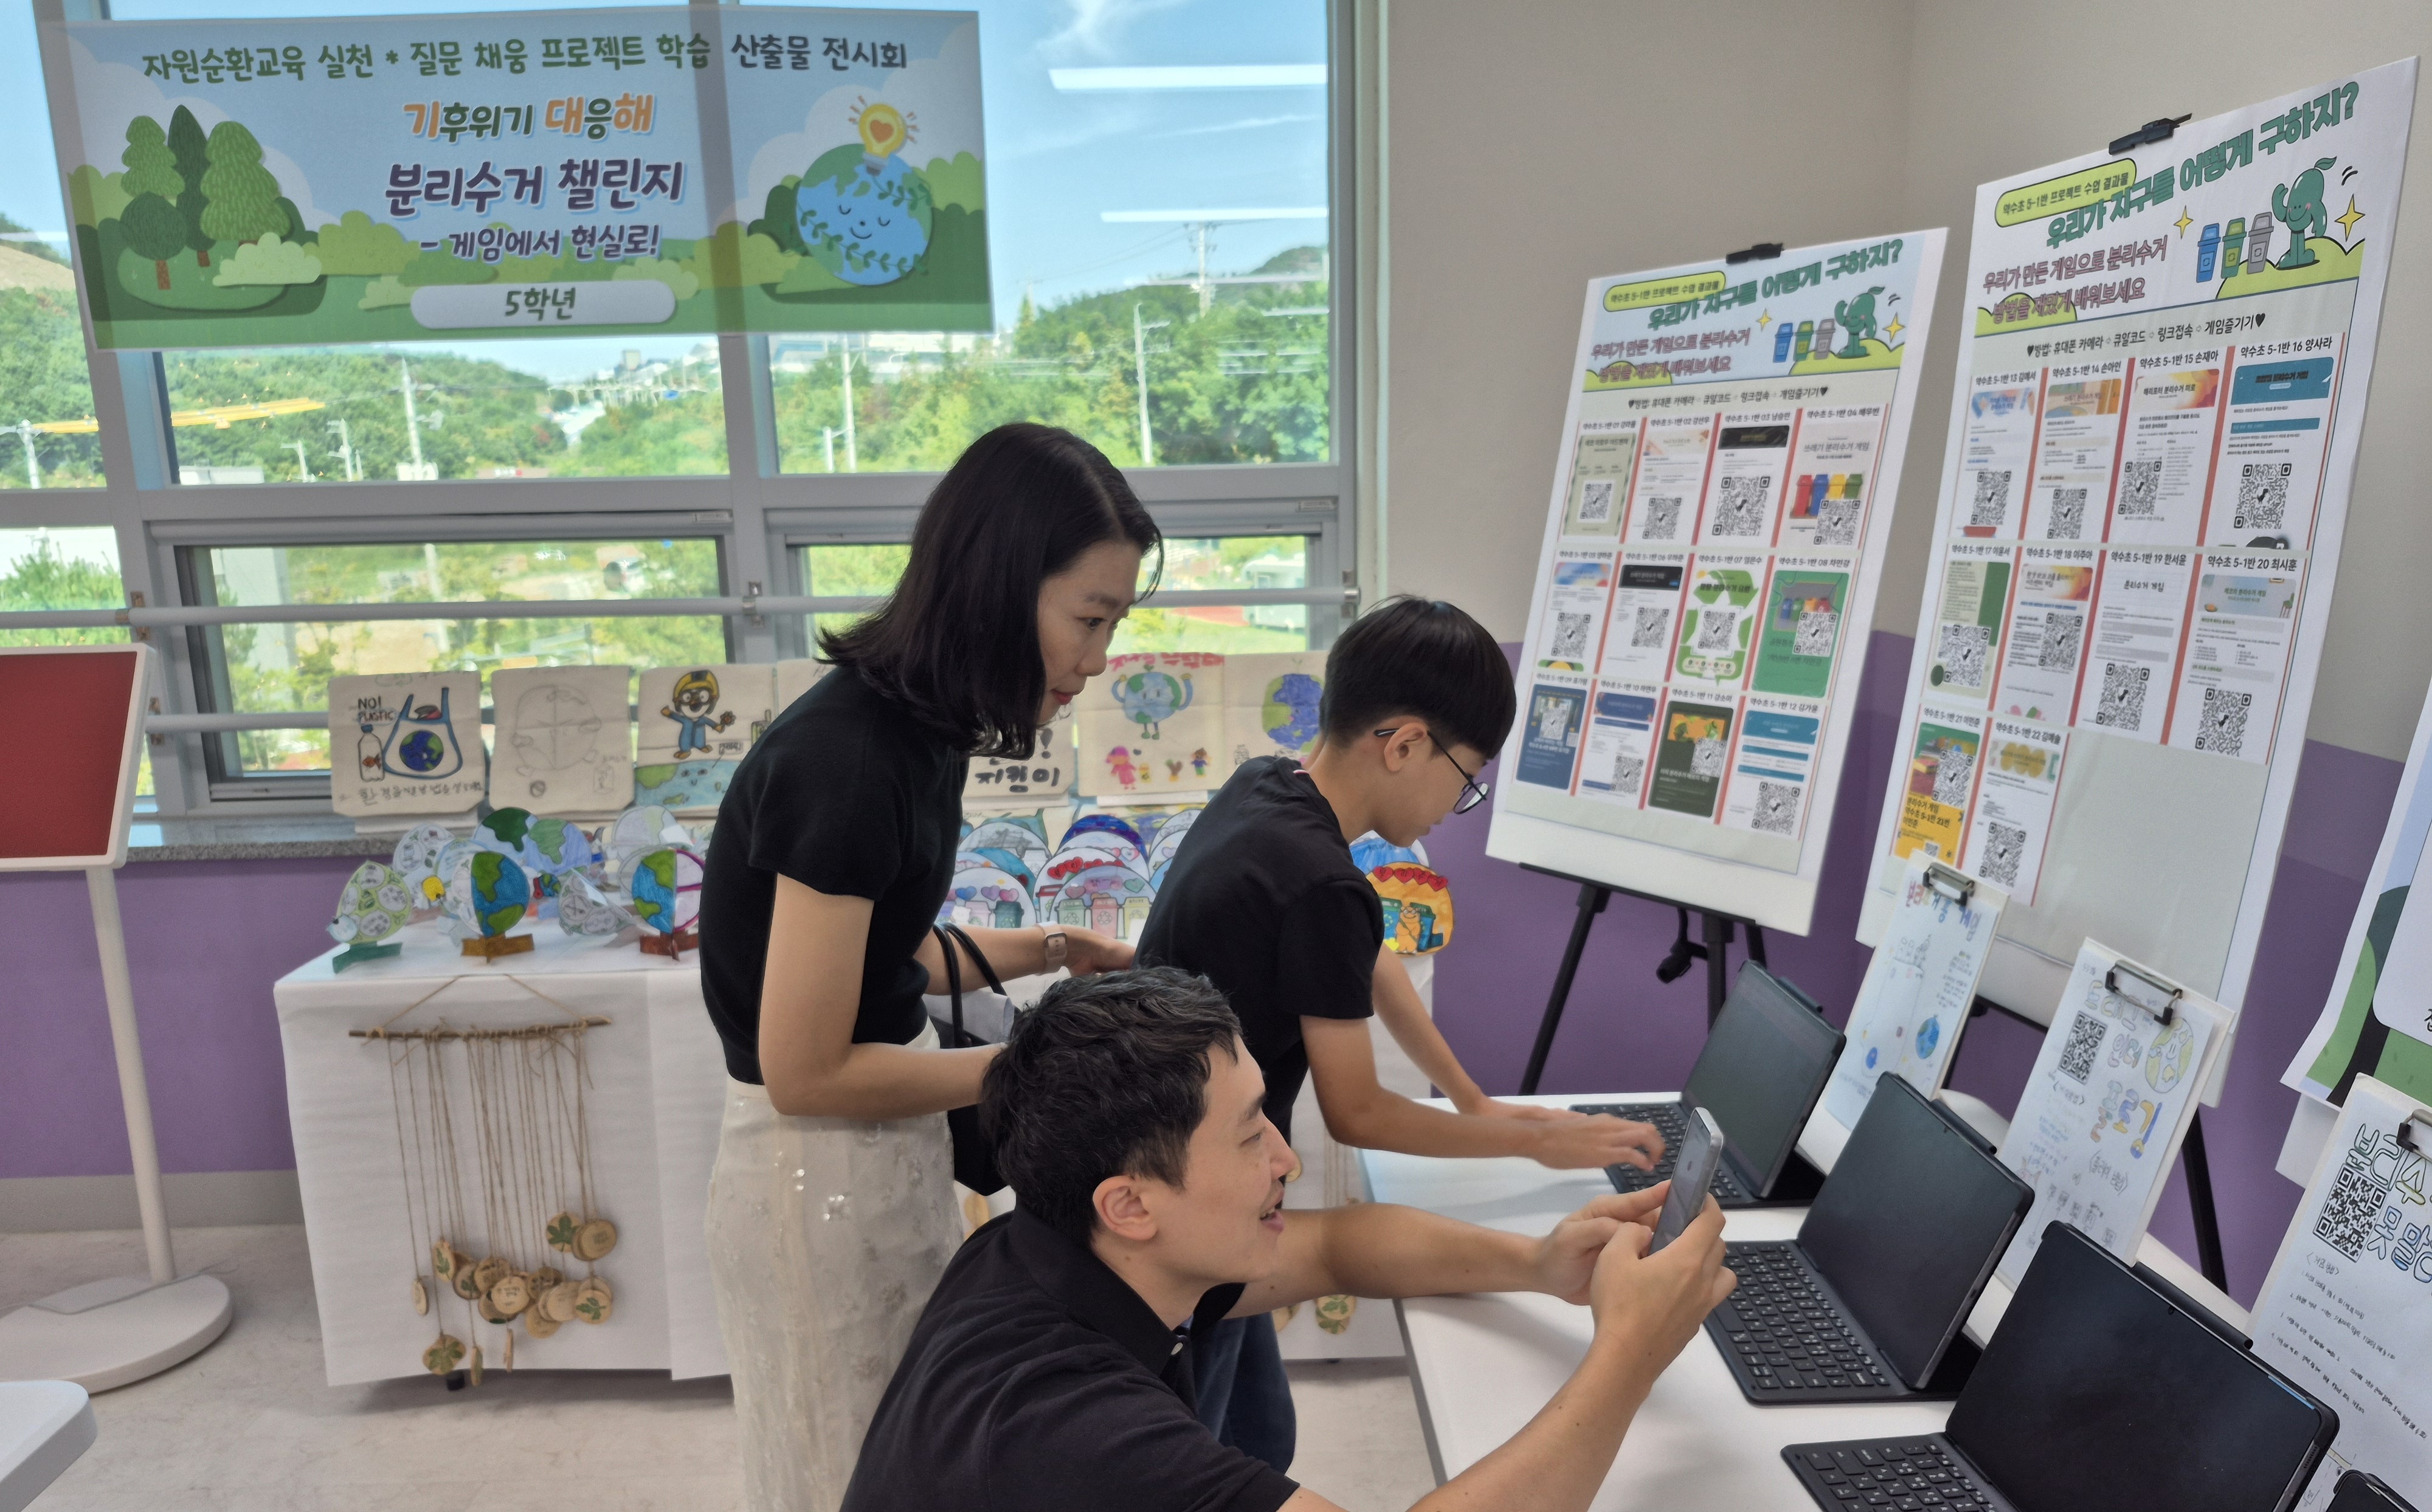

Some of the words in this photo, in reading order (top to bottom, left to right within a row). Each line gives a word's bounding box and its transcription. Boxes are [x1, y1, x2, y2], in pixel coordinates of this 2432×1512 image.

[142, 46, 305, 79] 자원순환교육
[317, 44, 373, 76] 실천
[410, 39, 461, 75] 질문
[475, 38, 528, 72] 채움
[542, 36, 644, 70] 프로젝트
[657, 33, 710, 69] 학습
[730, 35, 810, 69] 산출물
[823, 35, 908, 69] 전시회
[404, 101, 533, 140] 기후위기
[545, 92, 655, 135] 대응해
[2047, 207, 2106, 249] 우리가
[2110, 167, 2175, 221] 지구를
[2178, 129, 2254, 191] 어떻게
[2257, 81, 2360, 156] 구하지?
[385, 162, 544, 215] 분리수거
[558, 158, 686, 209] 챌린지
[2003, 198, 2024, 216] 약수초
[2026, 194, 2048, 211] 5-1반
[2050, 184, 2082, 207] 프로젝트
[2084, 179, 2101, 198] 수업
[2102, 171, 2129, 193] 결과물
[449, 228, 561, 260] 게임에서
[572, 224, 660, 257] 현실로!
[1983, 265, 2020, 294] 우리가
[2022, 260, 2045, 286] 만든
[2049, 250, 2104, 280] 게임으로
[2107, 235, 2168, 272] 분리수거
[1648, 300, 1700, 330] 우리가
[1703, 280, 1757, 313] 지구를
[1761, 261, 1822, 299] 어떻게
[1826, 238, 1903, 280] 구하지?
[1993, 294, 2030, 323] 방법을
[2074, 277, 2145, 310] 배워보세요
[505, 286, 576, 322] 5학년
[1591, 339, 1624, 360] 우리가
[1626, 335, 1648, 357] 만든
[1650, 333, 1698, 355] 게임으로
[1700, 328, 1750, 350] 분리수거
[2053, 340, 2076, 354] 휴대폰
[2079, 336, 2103, 350] 카메라
[2158, 323, 2193, 342] 링크접속
[2205, 312, 2254, 335] 게임즐기기
[2241, 345, 2265, 358] 약수초
[2267, 341, 2290, 354] 5-1반
[2292, 341, 2303, 351] 16
[2306, 336, 2332, 351] 양사라
[1672, 356, 1730, 376] 배워보세요
[2053, 367, 2071, 378] 약수초
[2140, 357, 2161, 369] 약수초
[2163, 354, 2183, 366] 5-1반
[2184, 354, 2194, 364] 15
[2195, 350, 2219, 364] 손재아
[1673, 395, 1694, 406] 카메라
[2111, 551, 2131, 562] 약수초
[2154, 554, 2163, 563] 19
[2208, 556, 2231, 567] 약수초
[2234, 557, 2256, 569] 5-1반
[2258, 559, 2270, 569] 20
[2271, 559, 2296, 571] 최시훈
